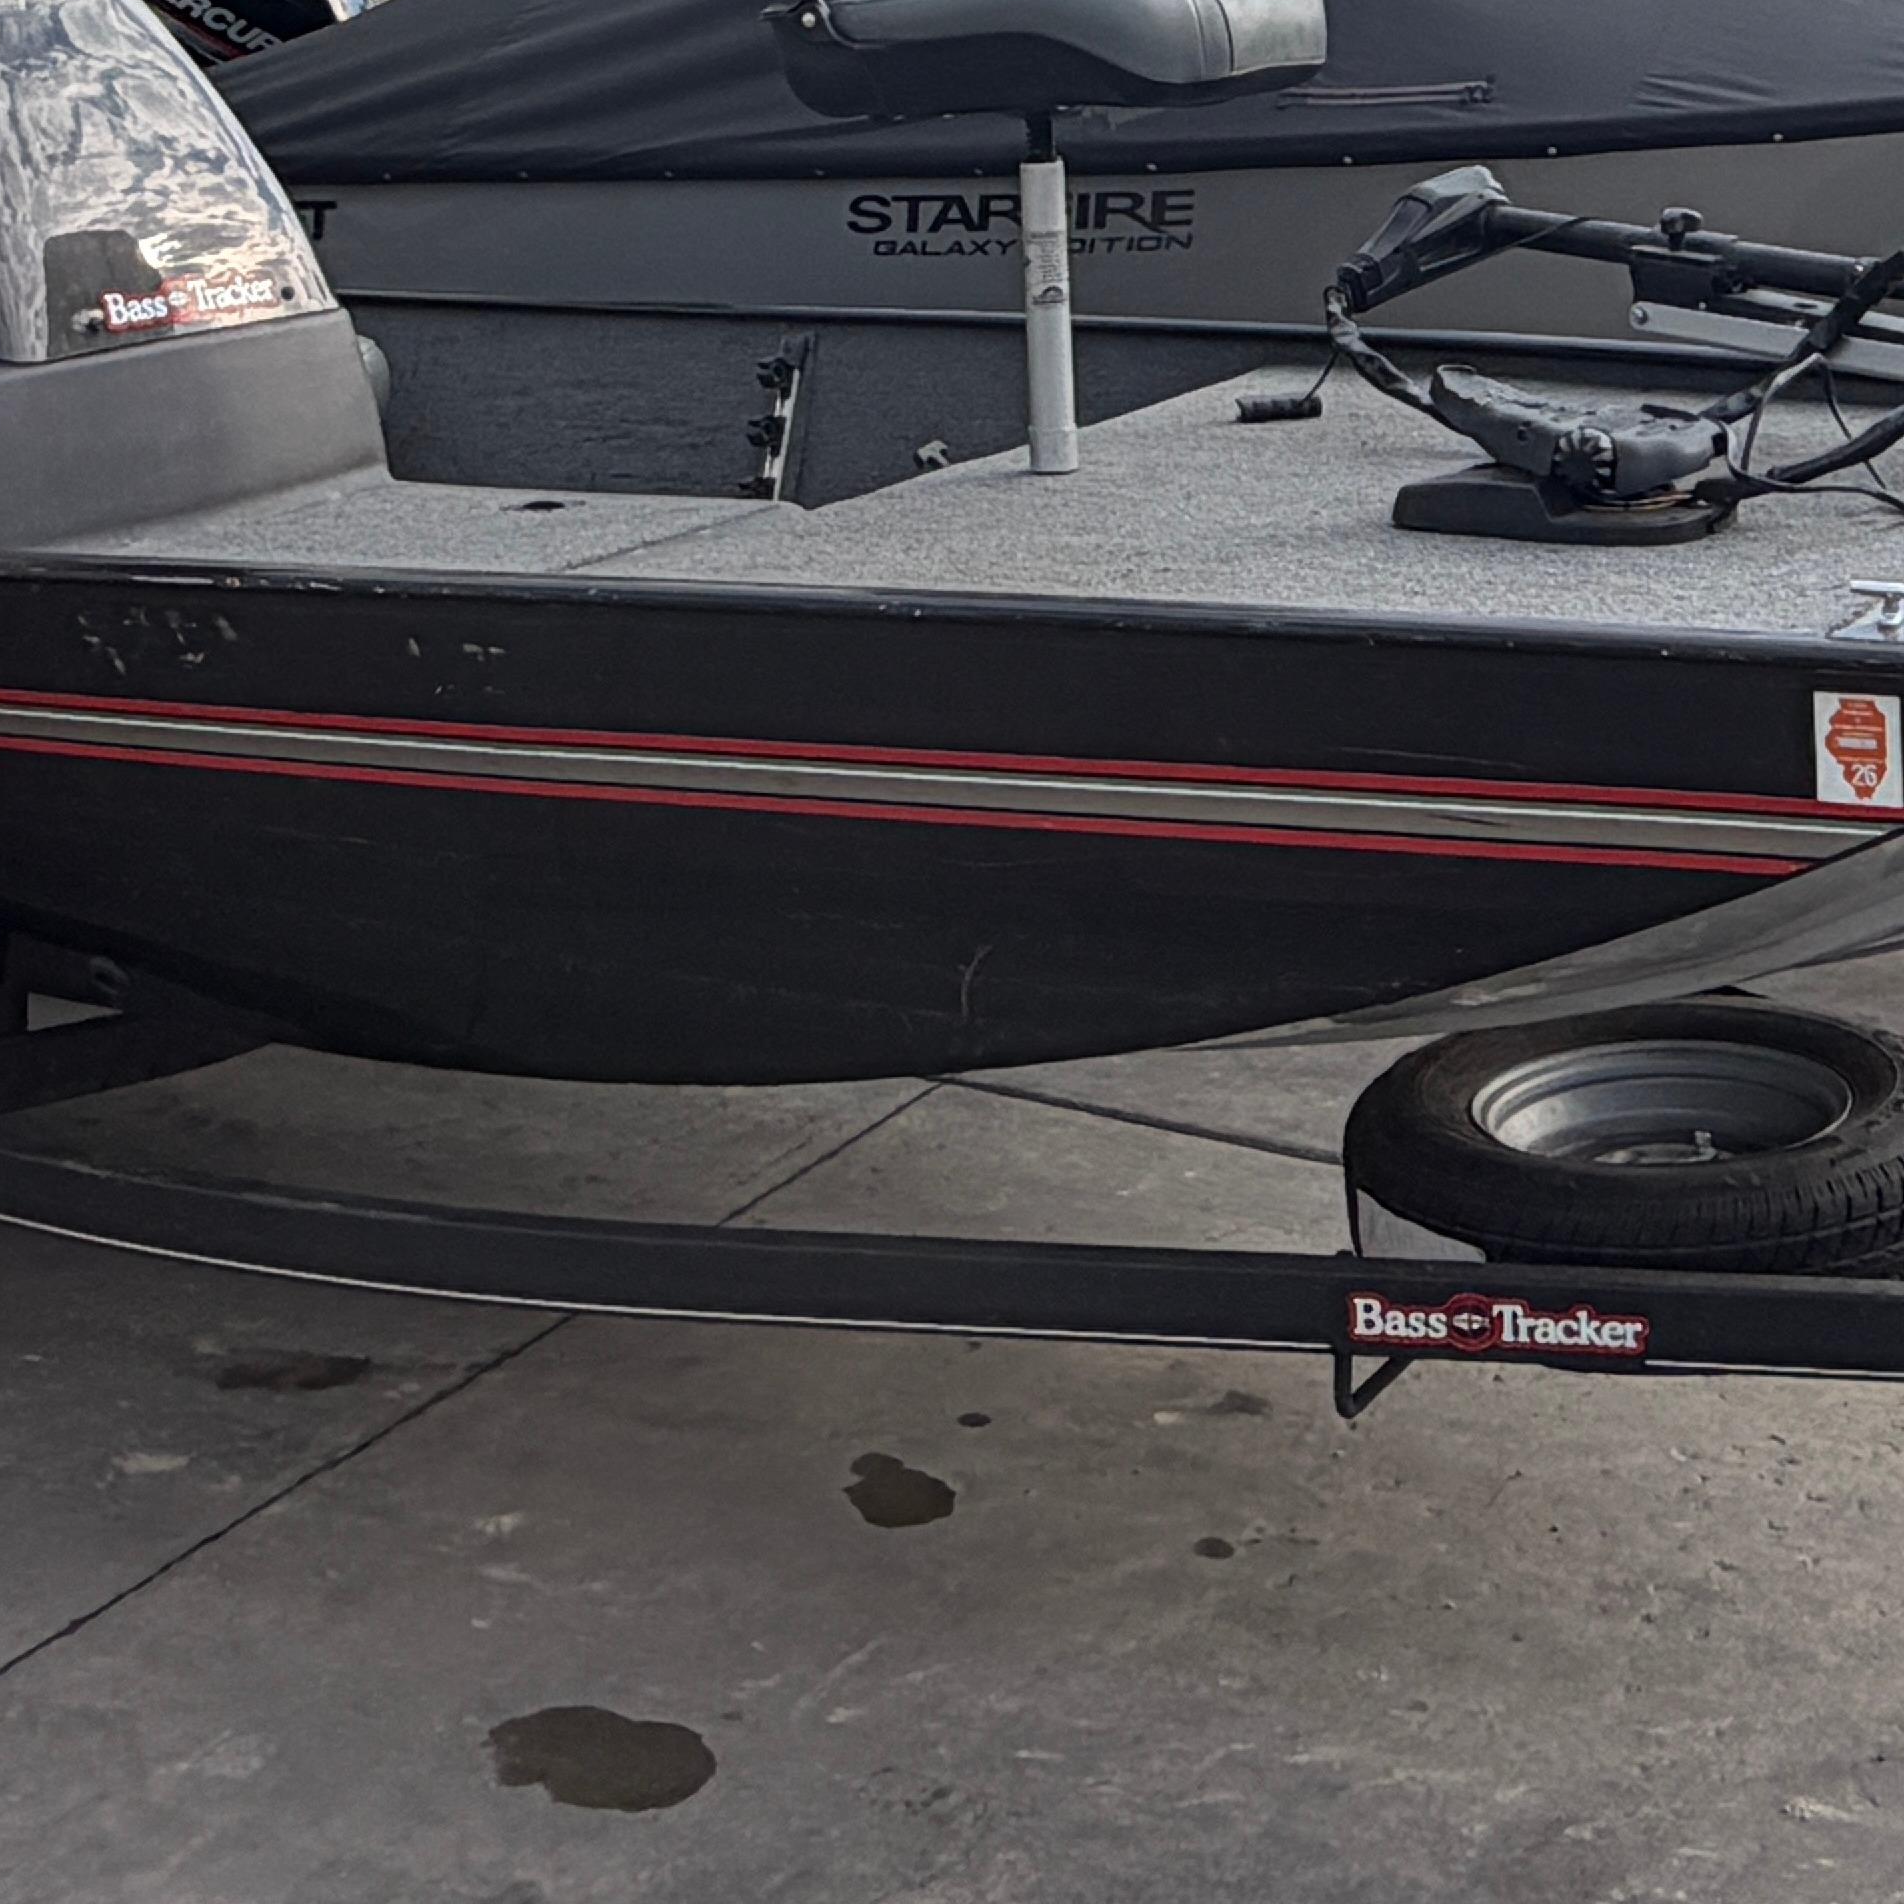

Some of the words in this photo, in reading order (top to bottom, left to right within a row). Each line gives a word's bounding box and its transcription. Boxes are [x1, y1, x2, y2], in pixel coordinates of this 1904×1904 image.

[847, 189, 1195, 234] STARIRE
[873, 239, 1017, 256] GALAXY
[1068, 233, 1194, 256] DITION
[103, 292, 168, 326] Bass
[187, 276, 273, 311] Tracker
[1851, 764, 1878, 788] 26
[1353, 1298, 1447, 1338] Bass
[1492, 1304, 1643, 1349] Tracker
